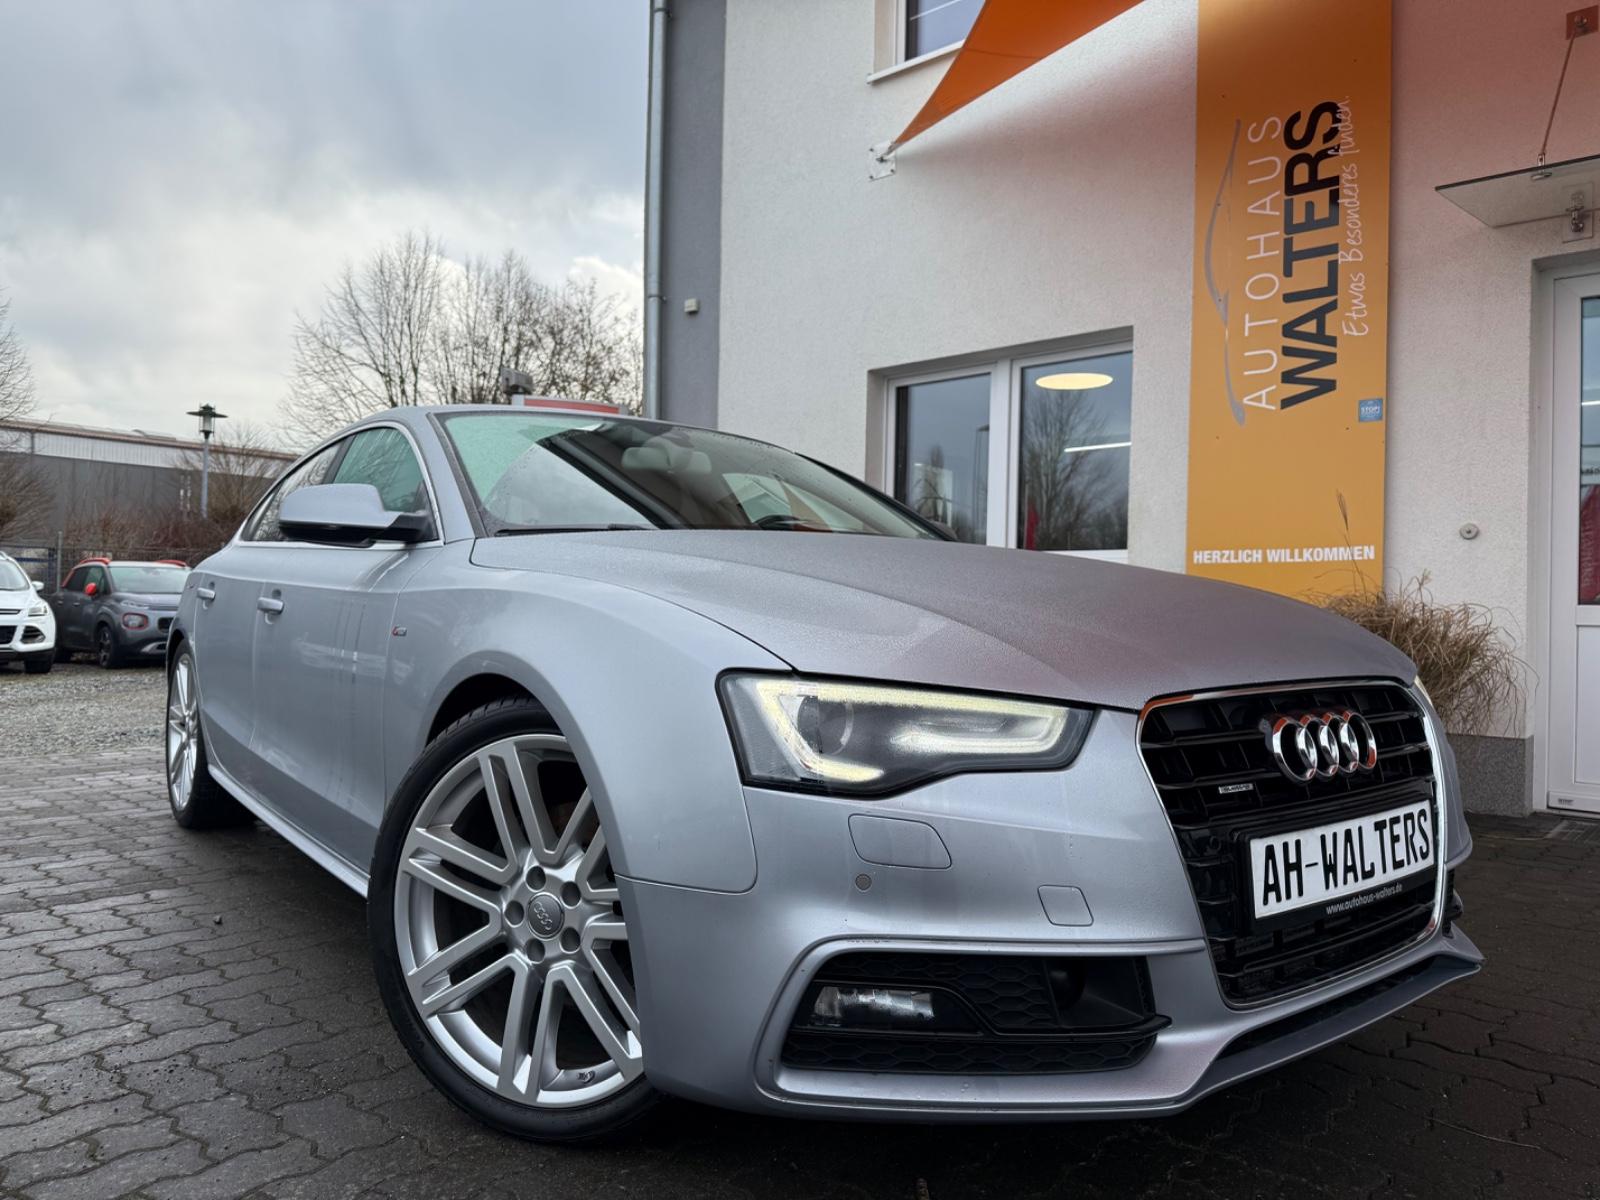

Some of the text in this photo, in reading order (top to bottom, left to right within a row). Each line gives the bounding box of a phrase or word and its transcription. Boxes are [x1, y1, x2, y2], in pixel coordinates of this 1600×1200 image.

[1243, 116, 1281, 410] AUTOHAUS
[1280, 101, 1340, 410] WALTERS
[1342, 272, 1369, 336] Etwas
[1193, 545, 1375, 564] HERZLICH WILLKOMMEN
[1263, 808, 1430, 906] AH-WALTERS
